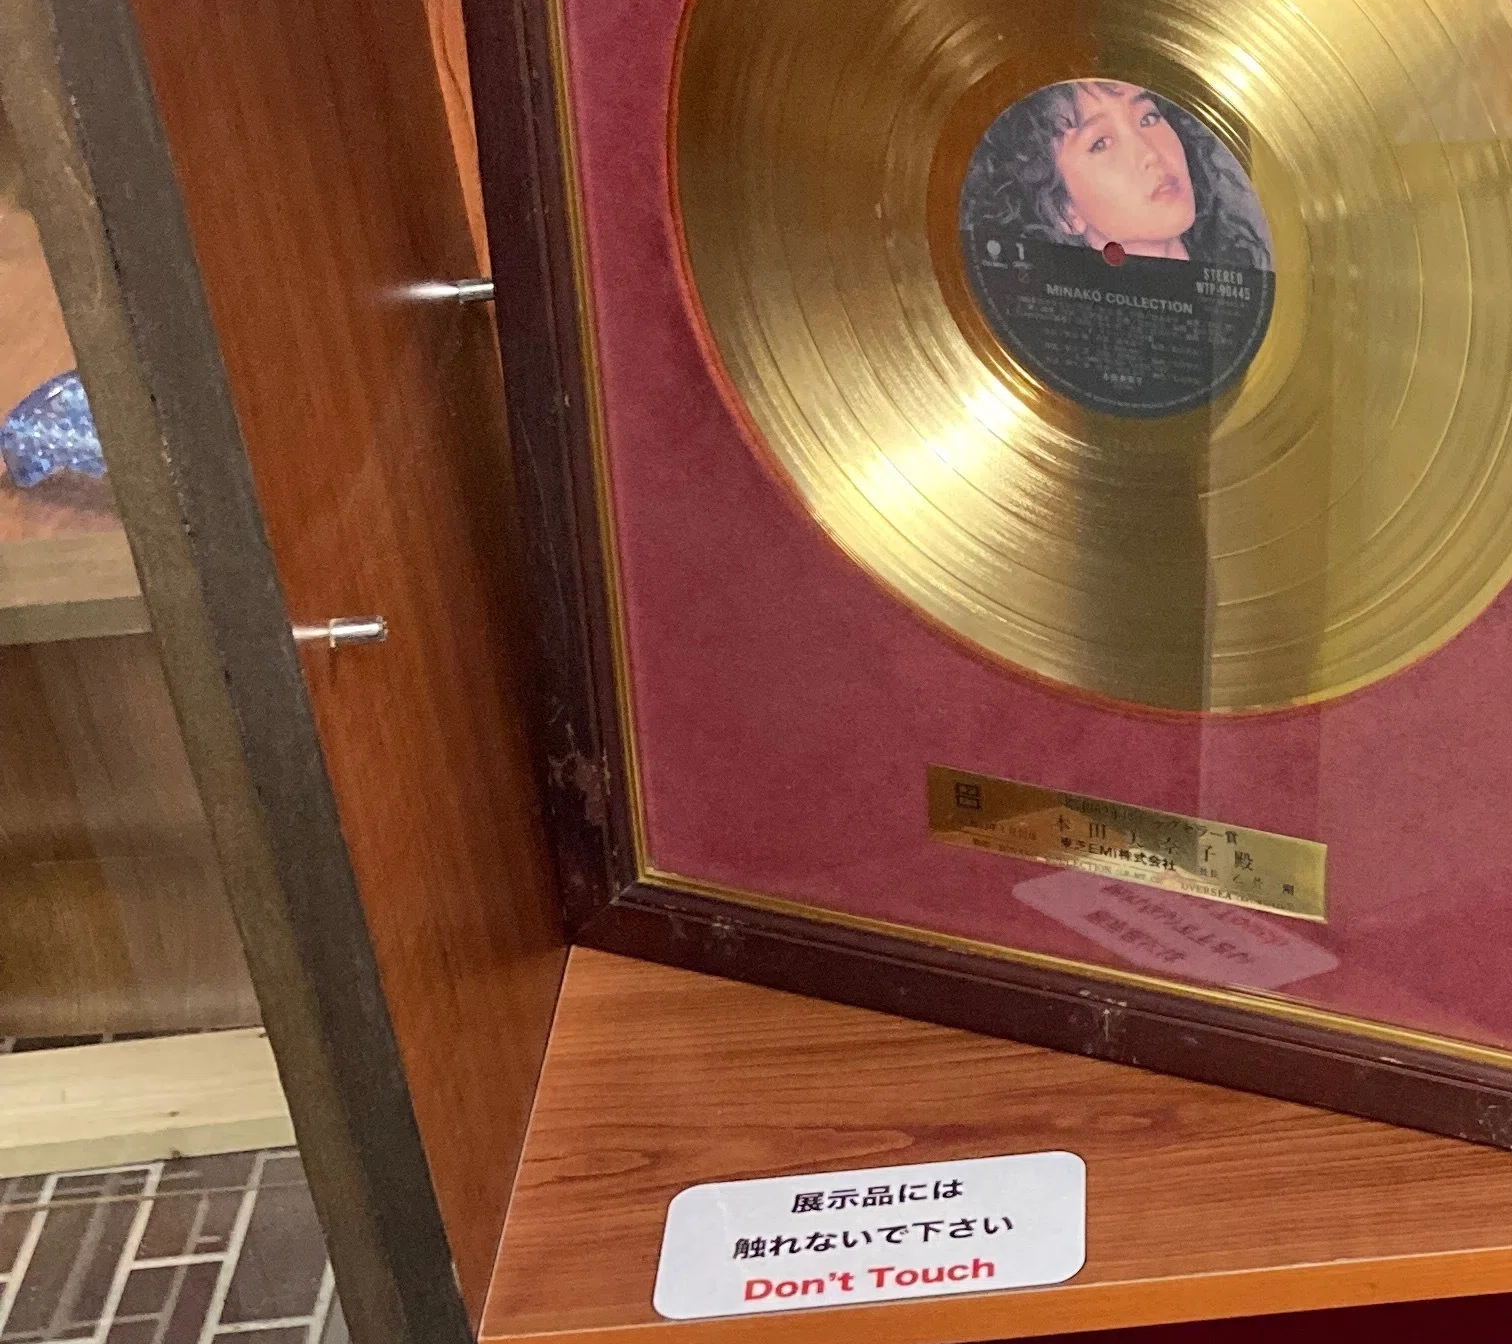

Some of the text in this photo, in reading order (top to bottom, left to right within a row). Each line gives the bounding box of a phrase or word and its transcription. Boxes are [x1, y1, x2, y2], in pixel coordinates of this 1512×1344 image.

[1202, 267, 1244, 287] STEREO
[1045, 283, 1102, 303] MINAKO
[1105, 291, 1194, 315] COLLECTION
[790, 1178, 964, 1214] 展示品には
[732, 1215, 1014, 1260] 触れないで下さい
[744, 1258, 996, 1301] Don't Touch
